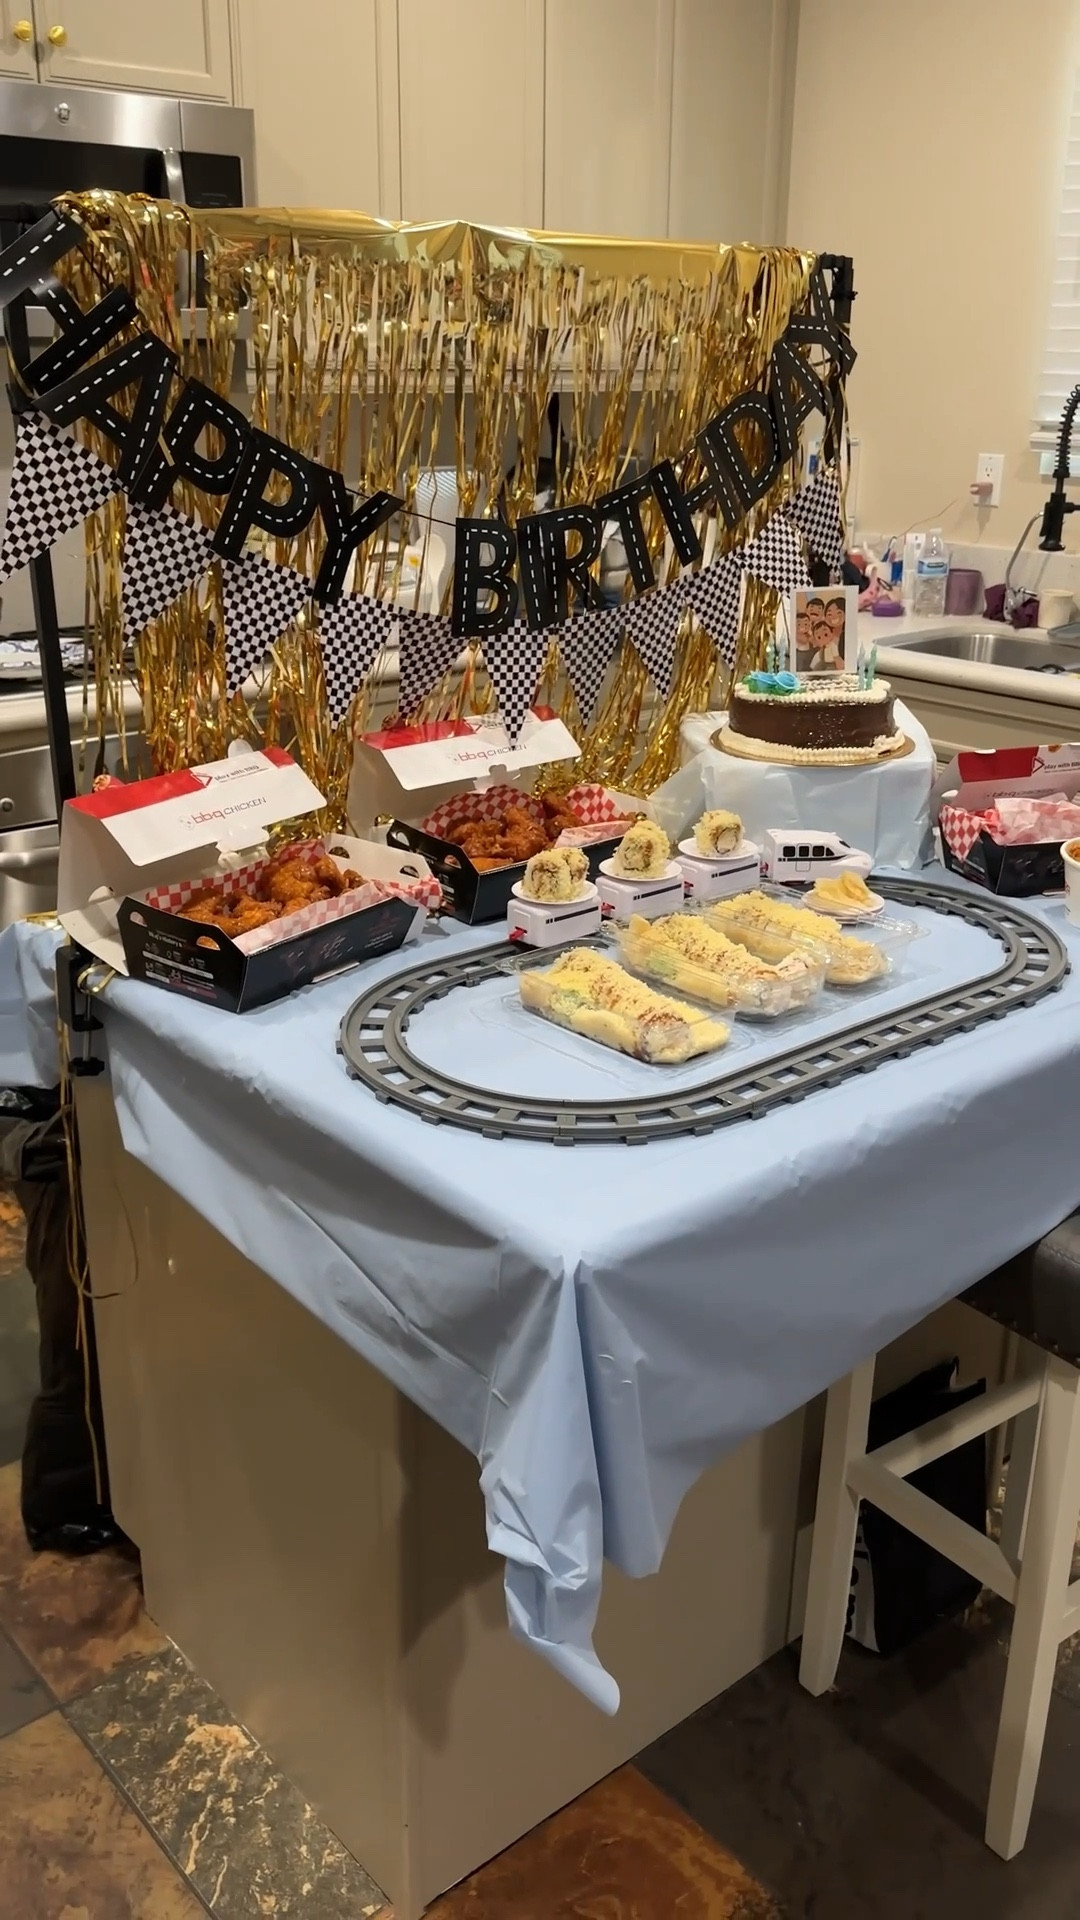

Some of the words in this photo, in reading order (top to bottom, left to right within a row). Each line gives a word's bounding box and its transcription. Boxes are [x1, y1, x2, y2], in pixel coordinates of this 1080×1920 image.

[0, 204, 405, 605] HAPPY
[451, 256, 858, 637] BIRTHDAY
[223, 797, 267, 815] CHICKEN
